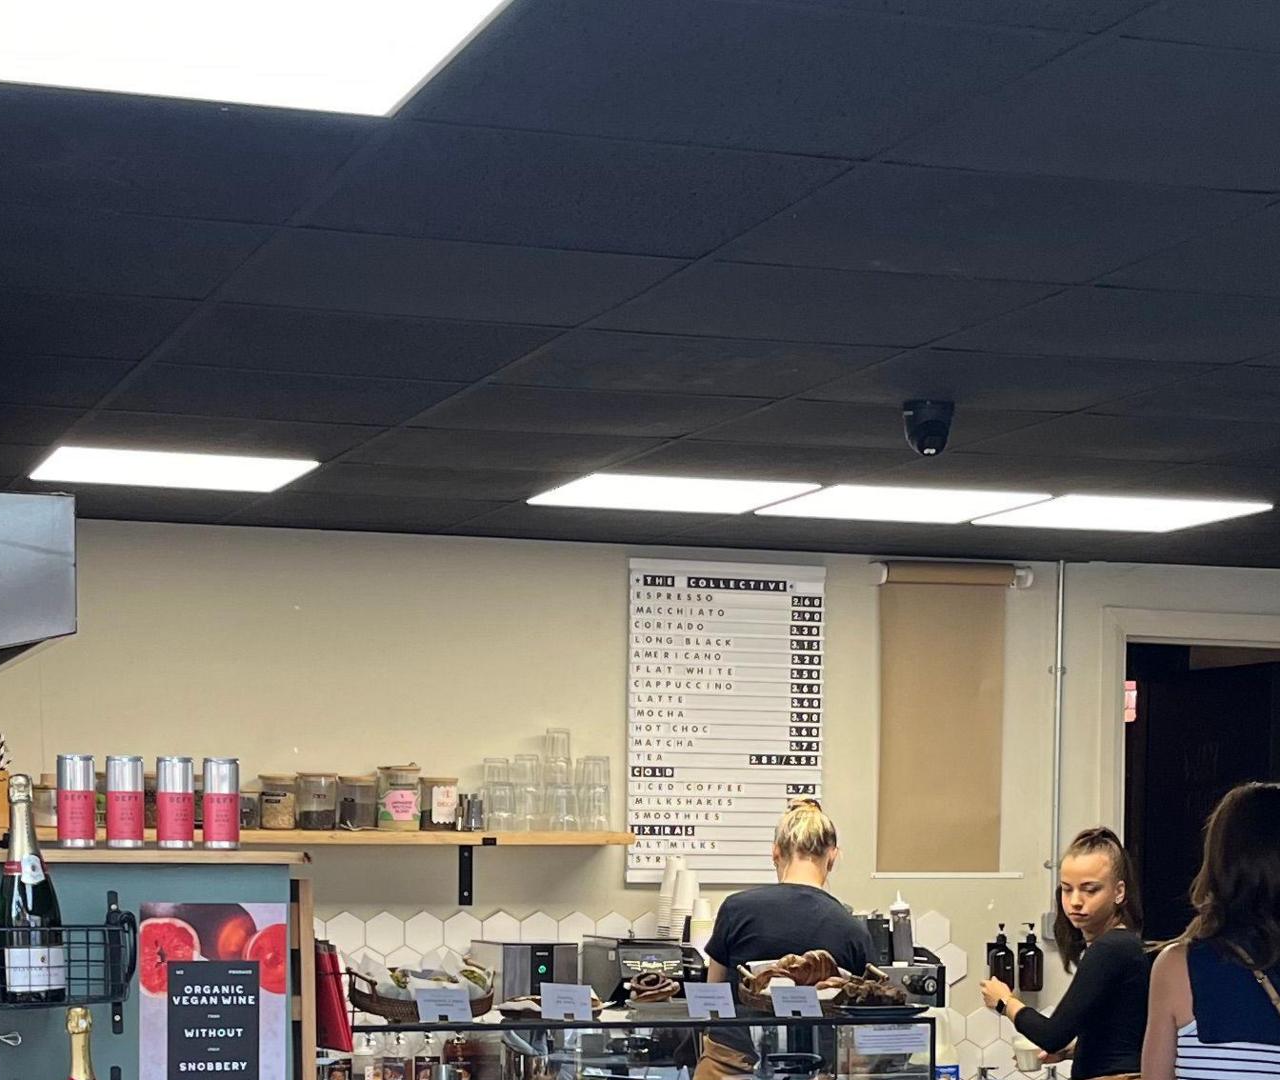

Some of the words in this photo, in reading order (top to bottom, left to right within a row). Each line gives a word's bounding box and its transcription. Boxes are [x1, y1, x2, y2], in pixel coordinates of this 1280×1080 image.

[645, 576, 673, 586] THE
[689, 578, 785, 591] COLLECTIVE
[636, 592, 713, 602] ESPRESSO
[792, 597, 821, 607] 2.60
[635, 607, 725, 617] MACCHIATO
[792, 612, 820, 621] 2.90
[634, 620, 704, 631] CORTADO
[635, 635, 673, 645] LONG
[685, 638, 732, 647] BLACK
[790, 641, 818, 650] 3.15
[633, 650, 721, 661] AMERICANO
[792, 655, 820, 664] 3.20
[635, 665, 673, 674] FLAT
[686, 667, 732, 676] WHITE
[791, 670, 819, 679] 3.50
[633, 680, 732, 690] CAPPUCCINO
[637, 695, 683, 703] LATTE
[636, 709, 684, 718] MOCHA
[672, 725, 708, 733] CHOC
[790, 728, 818, 737] 3.60
[634, 739, 694, 747] MATCHA
[790, 742, 817, 751] 3.75
[633, 768, 673, 777] COLD
[637, 783, 674, 791] ICED
[686, 784, 742, 792] COFFEE
[635, 797, 733, 806] MILKSHAKES
[634, 812, 720, 820] SMOOTHIES
[632, 826, 694, 835] EXTRAS
[635, 841, 661, 849] ALT
[670, 841, 716, 849] MILKS
[183, 985, 244, 994] ORGANIC
[172, 996, 219, 1006] VEGAN
[221, 996, 256, 1005] WINE
[183, 1028, 244, 1038] WITHOUT
[178, 1061, 248, 1072] SNOBBERY
